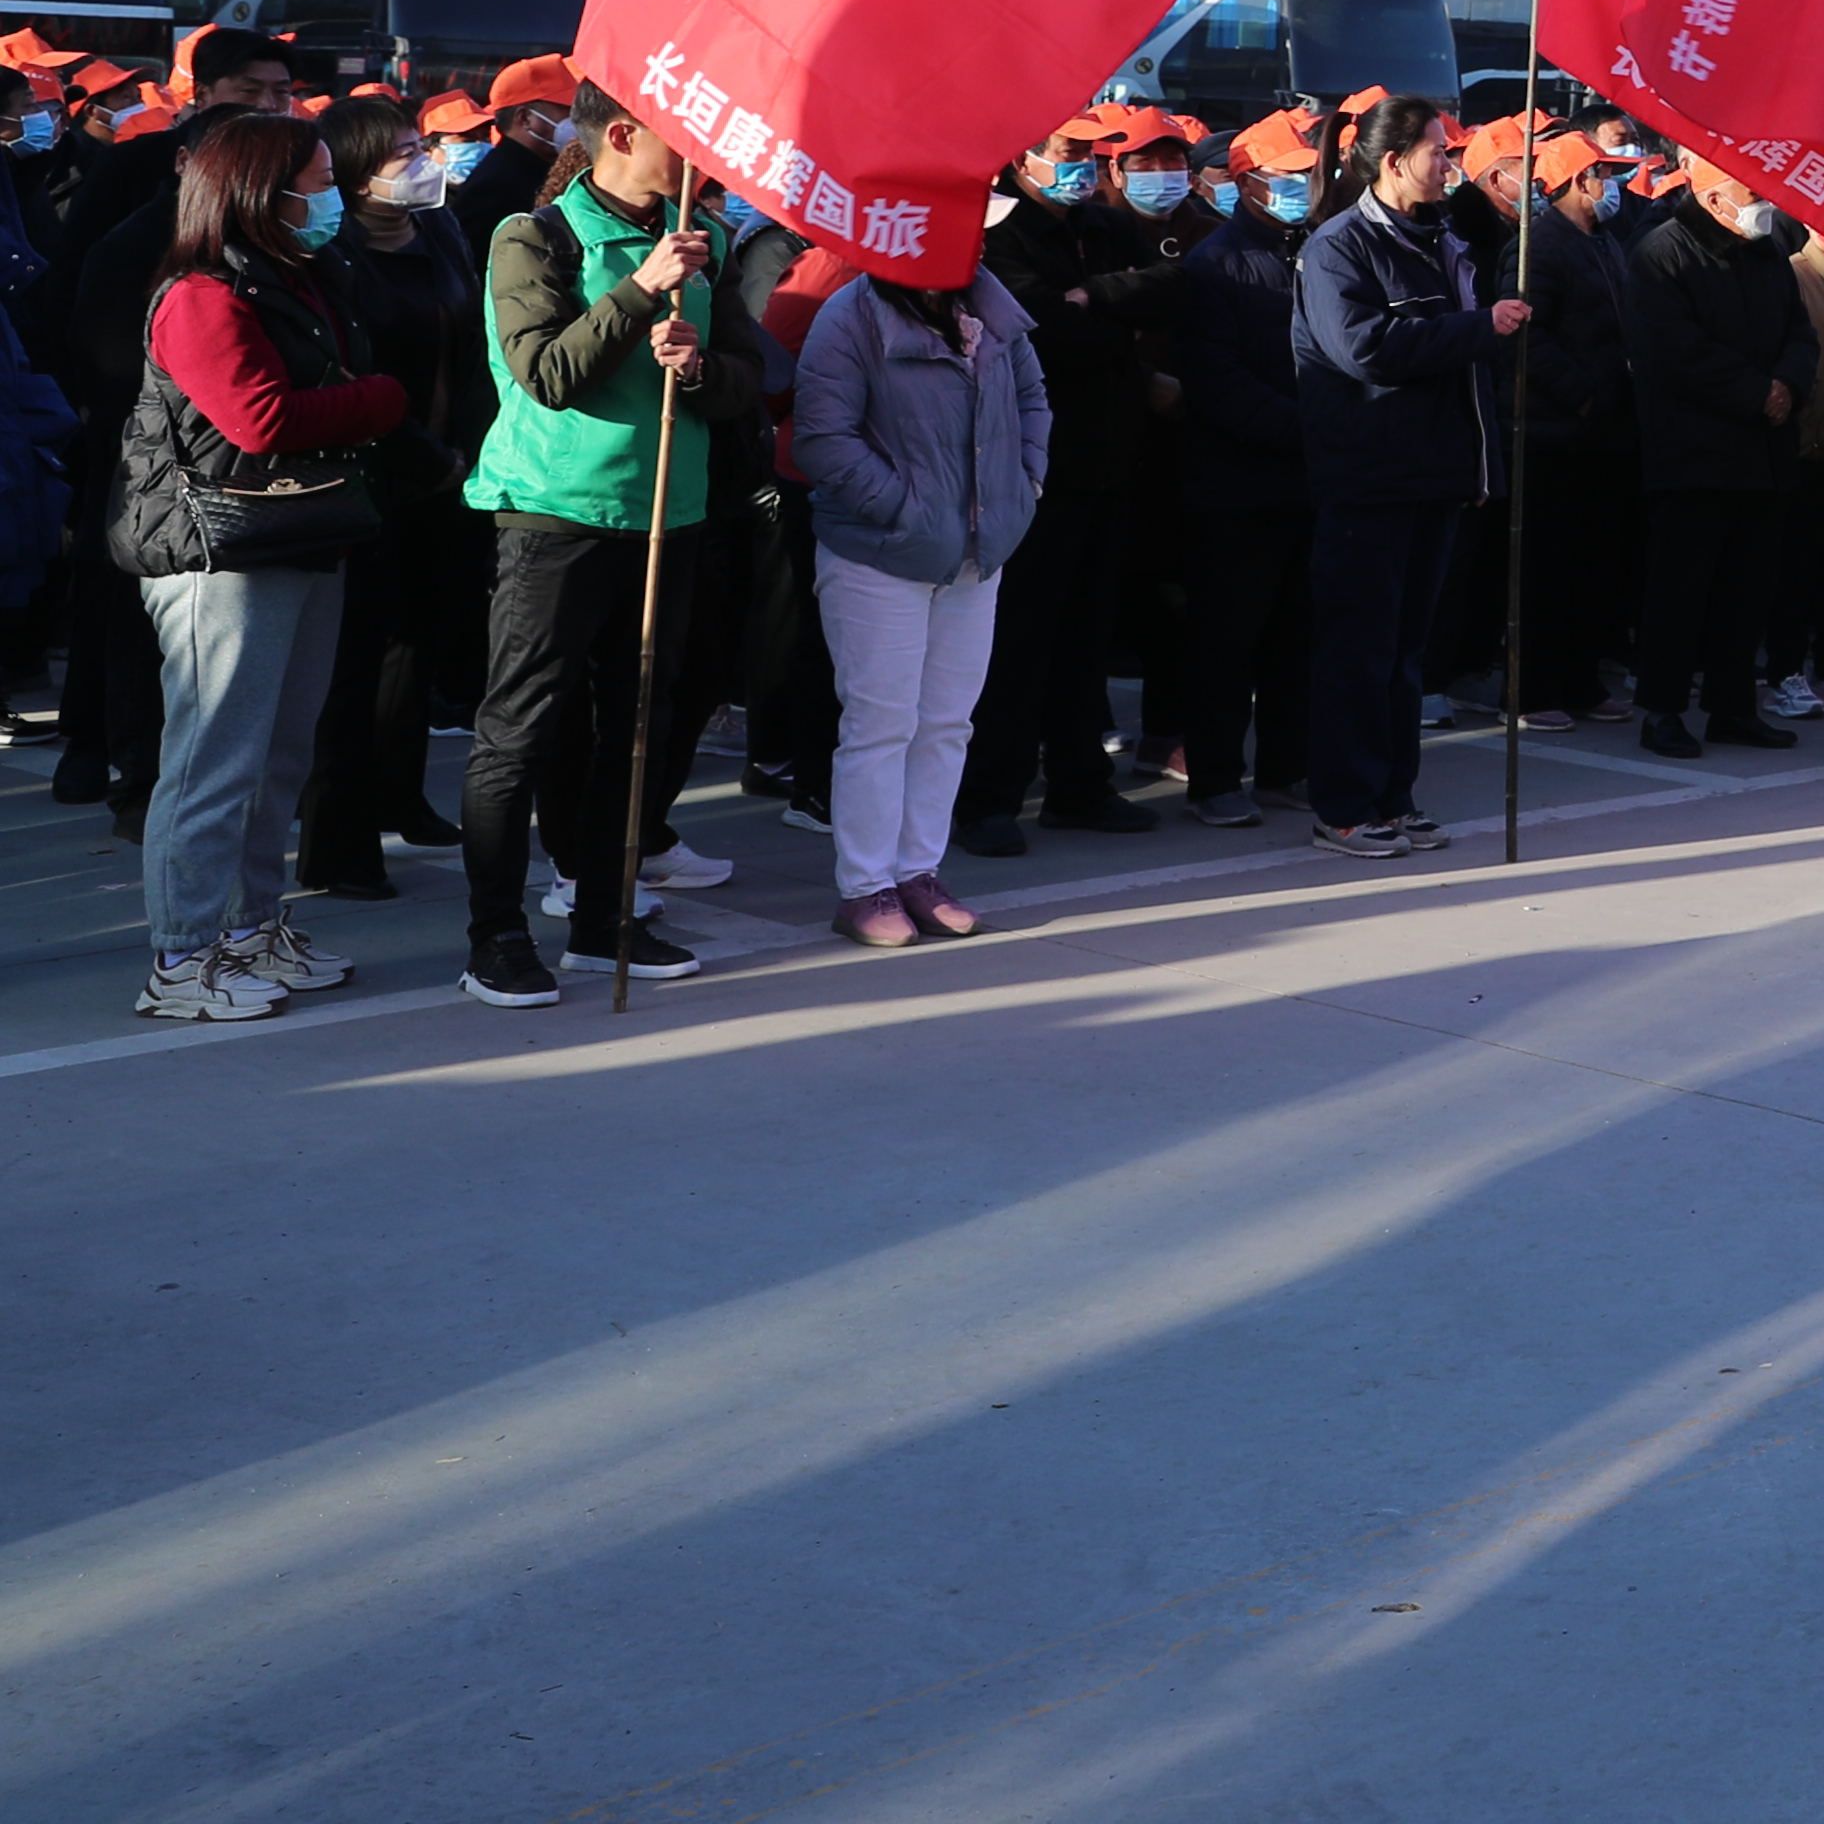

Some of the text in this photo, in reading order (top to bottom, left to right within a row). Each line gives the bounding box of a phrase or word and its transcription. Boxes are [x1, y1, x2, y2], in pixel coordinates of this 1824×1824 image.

[638, 42, 931, 260] 长垣康辉国旅
